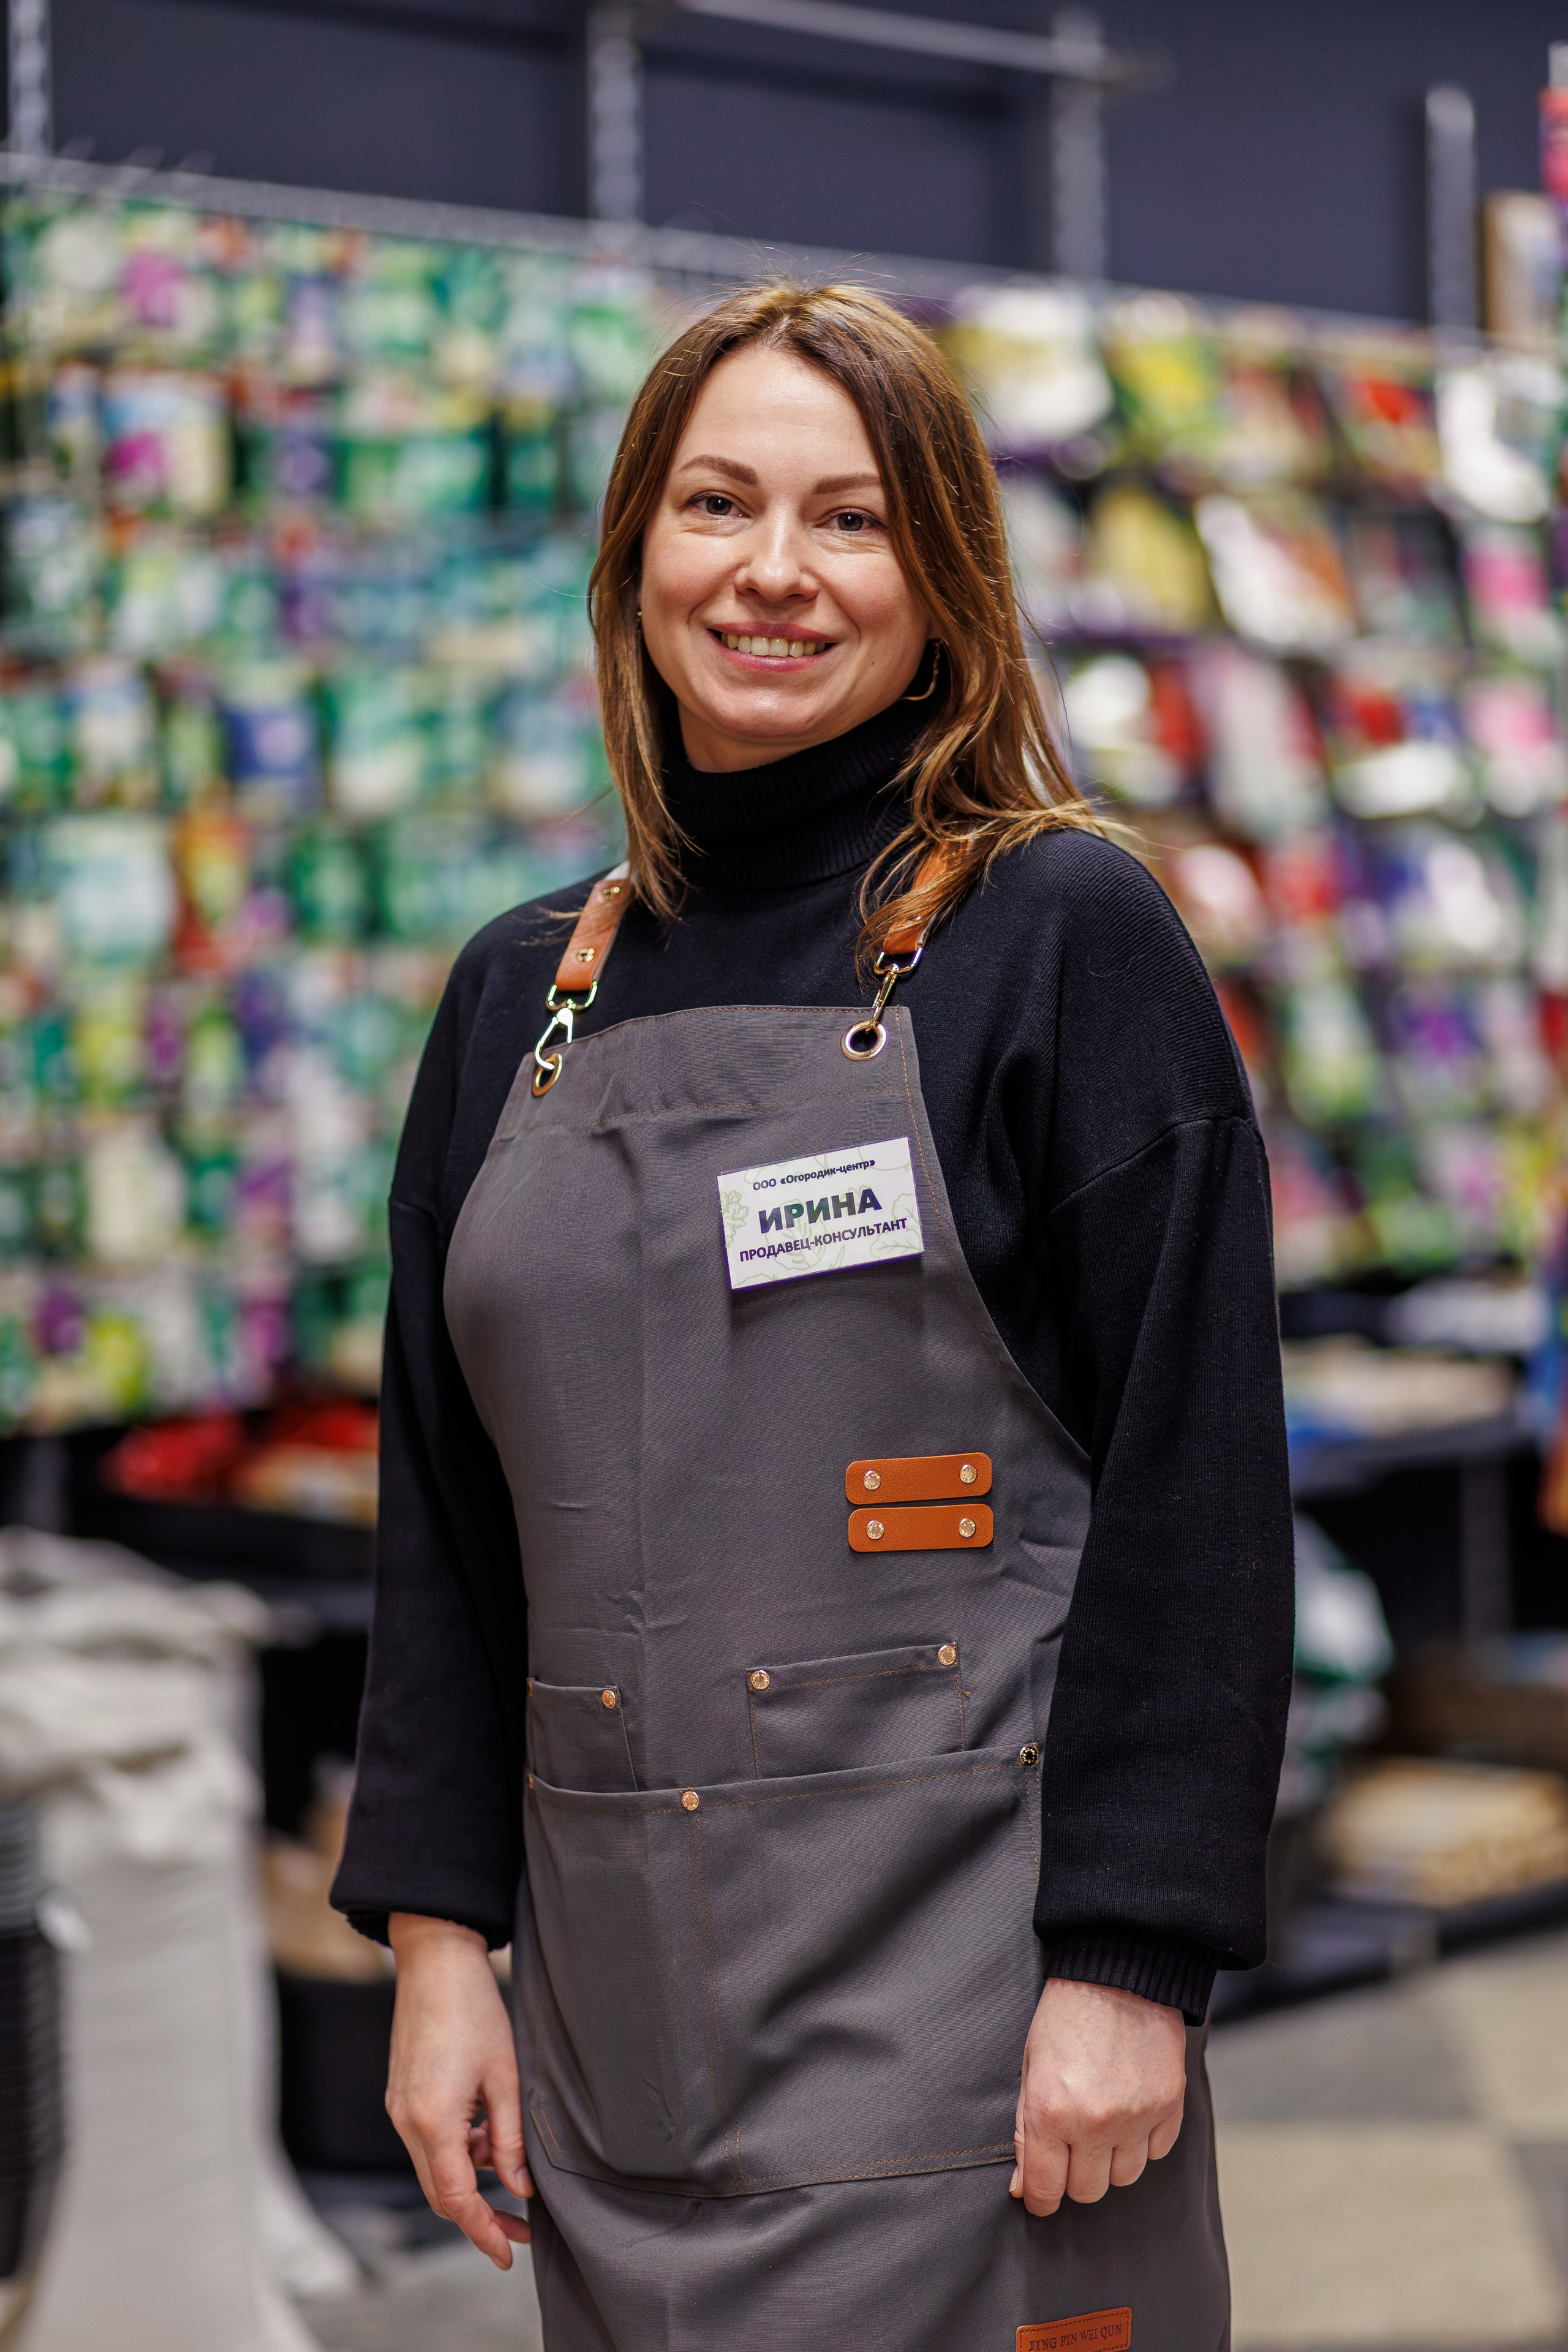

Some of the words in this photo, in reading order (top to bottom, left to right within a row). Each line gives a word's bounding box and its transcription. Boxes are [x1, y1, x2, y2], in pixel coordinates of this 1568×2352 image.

[753, 1178, 777, 1191] ООО
[780, 1159, 876, 1185] «Огородик-центр»
[758, 1188, 883, 1234] ИРИНА
[739, 1218, 907, 1262] ПРОДАВЕЦ-КОНСУЛЬТАНТ
[1060, 2333, 1078, 2347] PIN
[1080, 2328, 1098, 2342] WEI
[1101, 2324, 1121, 2340] QUN
